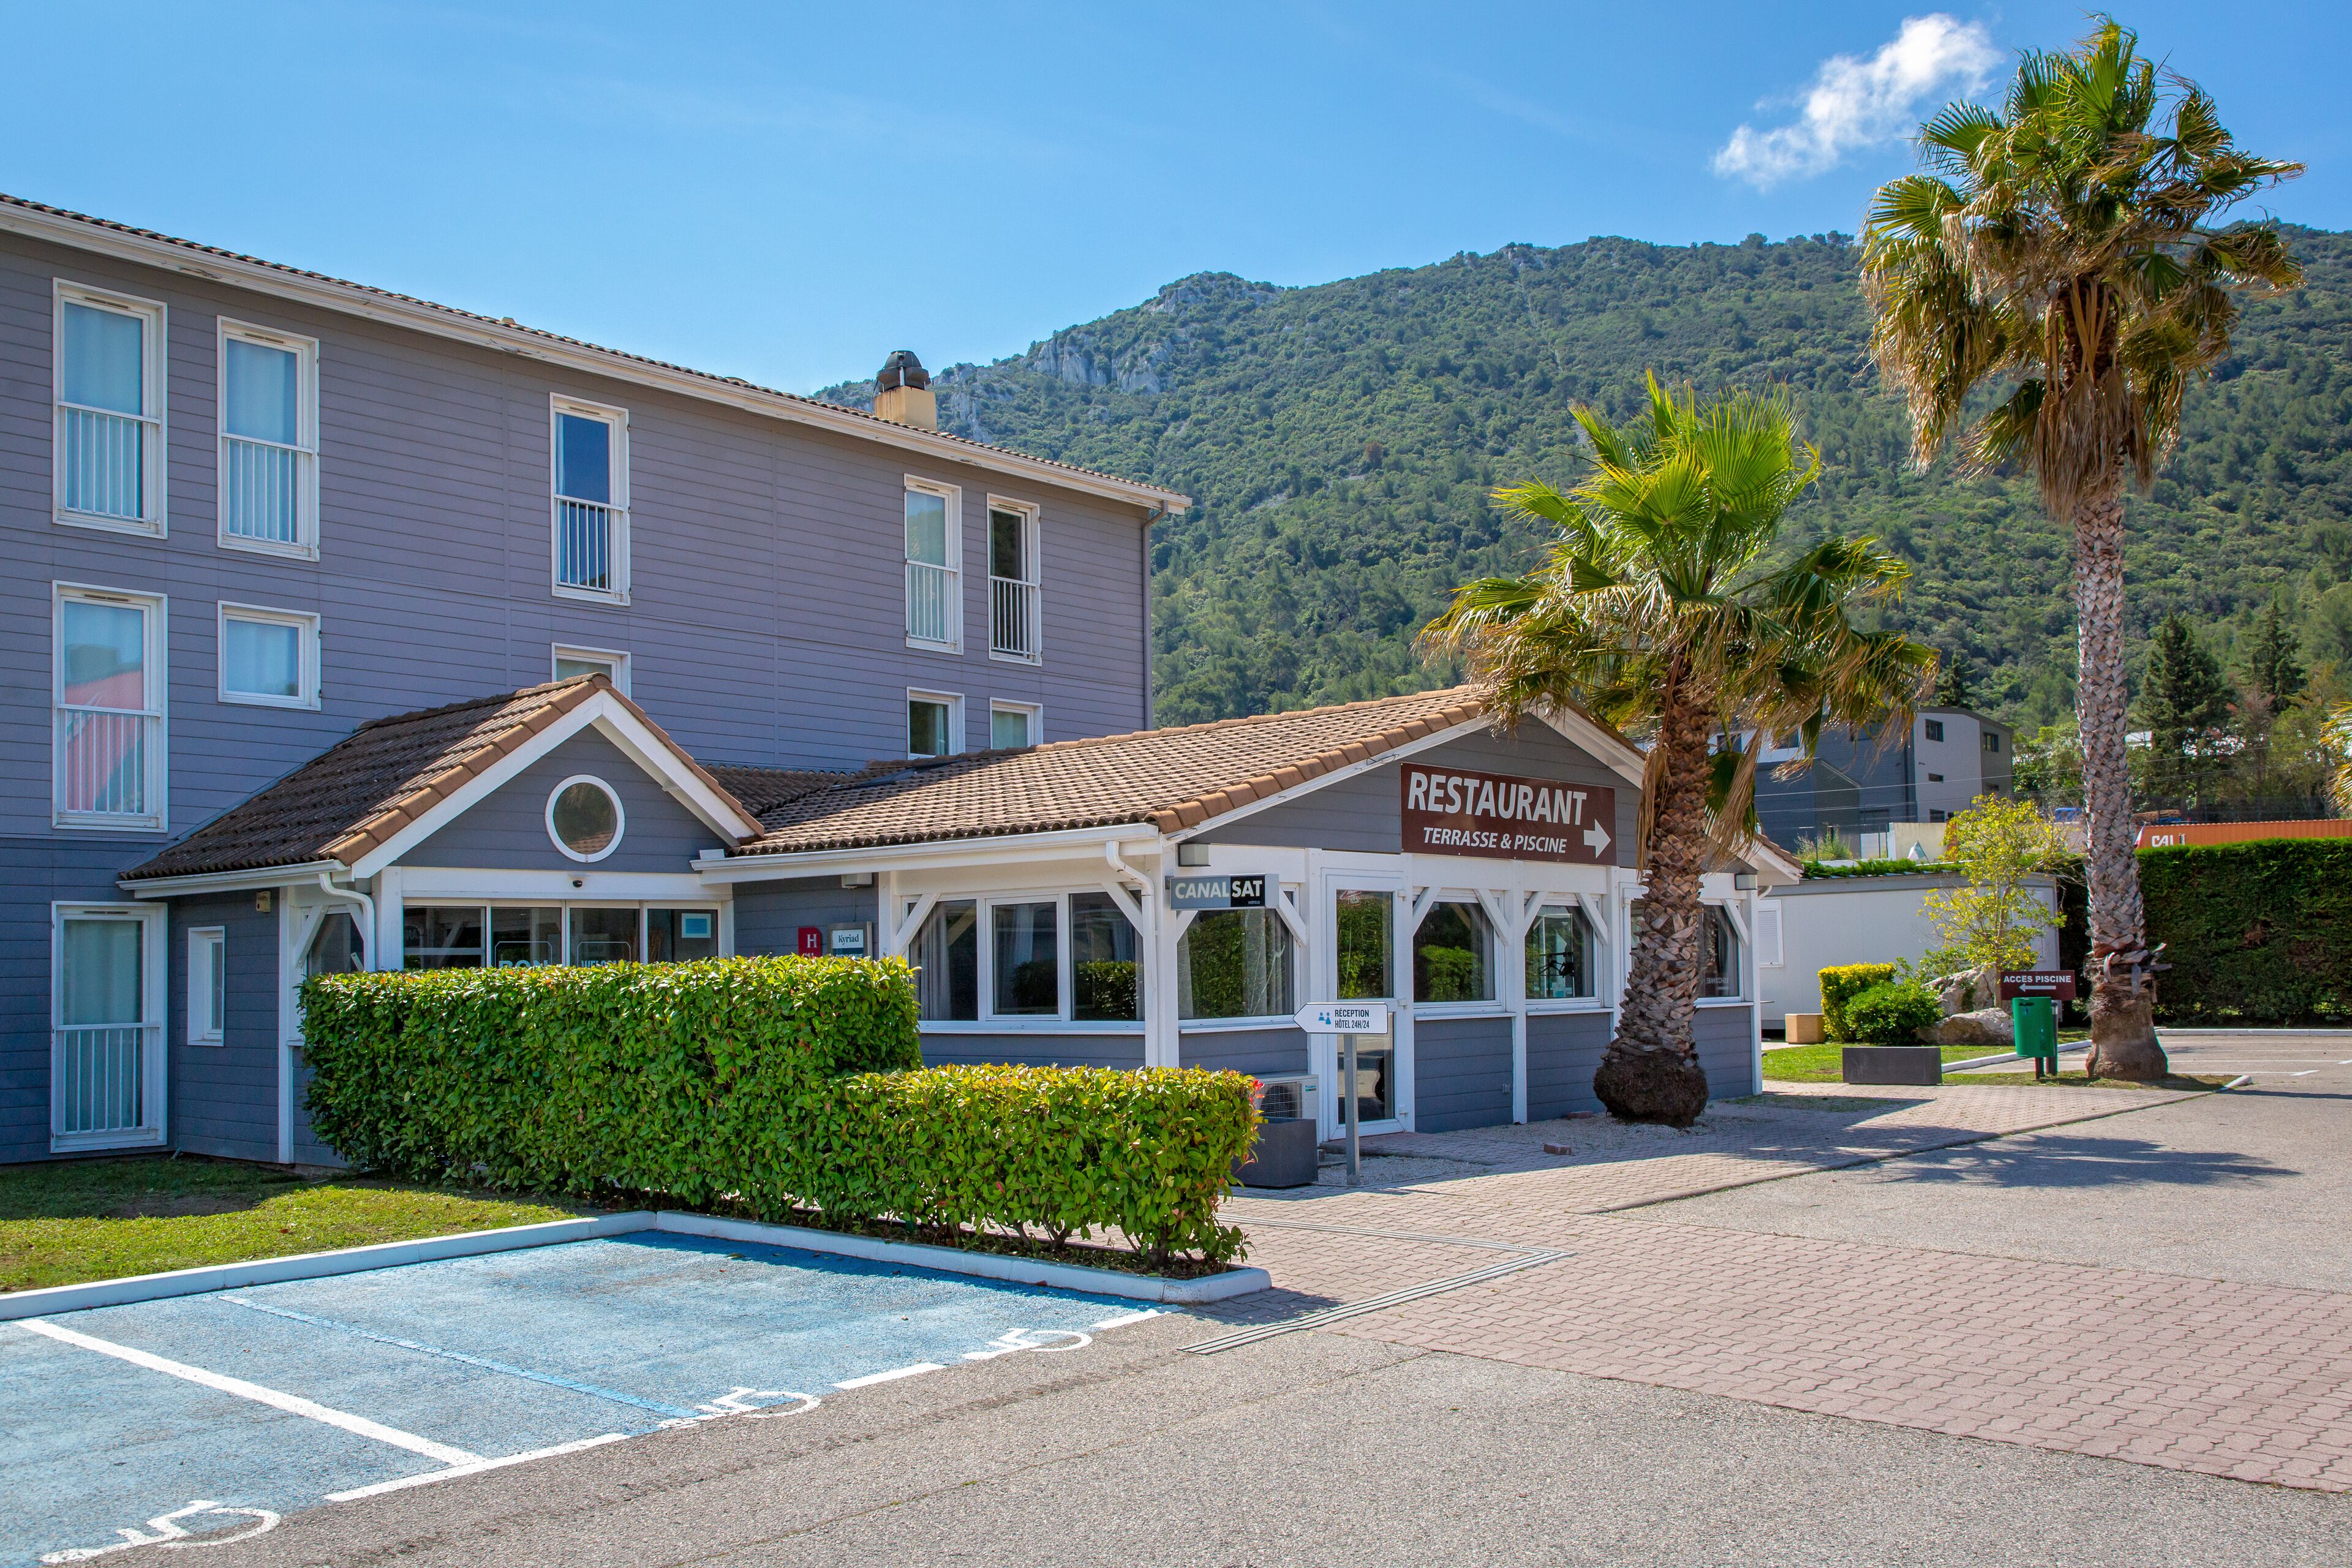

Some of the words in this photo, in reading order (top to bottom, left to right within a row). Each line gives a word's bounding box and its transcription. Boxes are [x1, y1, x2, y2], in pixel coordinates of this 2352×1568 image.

[1408, 772, 1587, 825] RESTAURANT
[1423, 827, 1498, 848] TERRASSE
[1500, 834, 1511, 850] &
[1514, 834, 1567, 853] PISCINE
[807, 933, 818, 948] H
[839, 934, 859, 945] Kyriad
[1335, 1008, 1370, 1017] RÉCEPTION
[1335, 1019, 1351, 1028] HÔTEL
[1351, 1020, 1370, 1030] 24H/24
